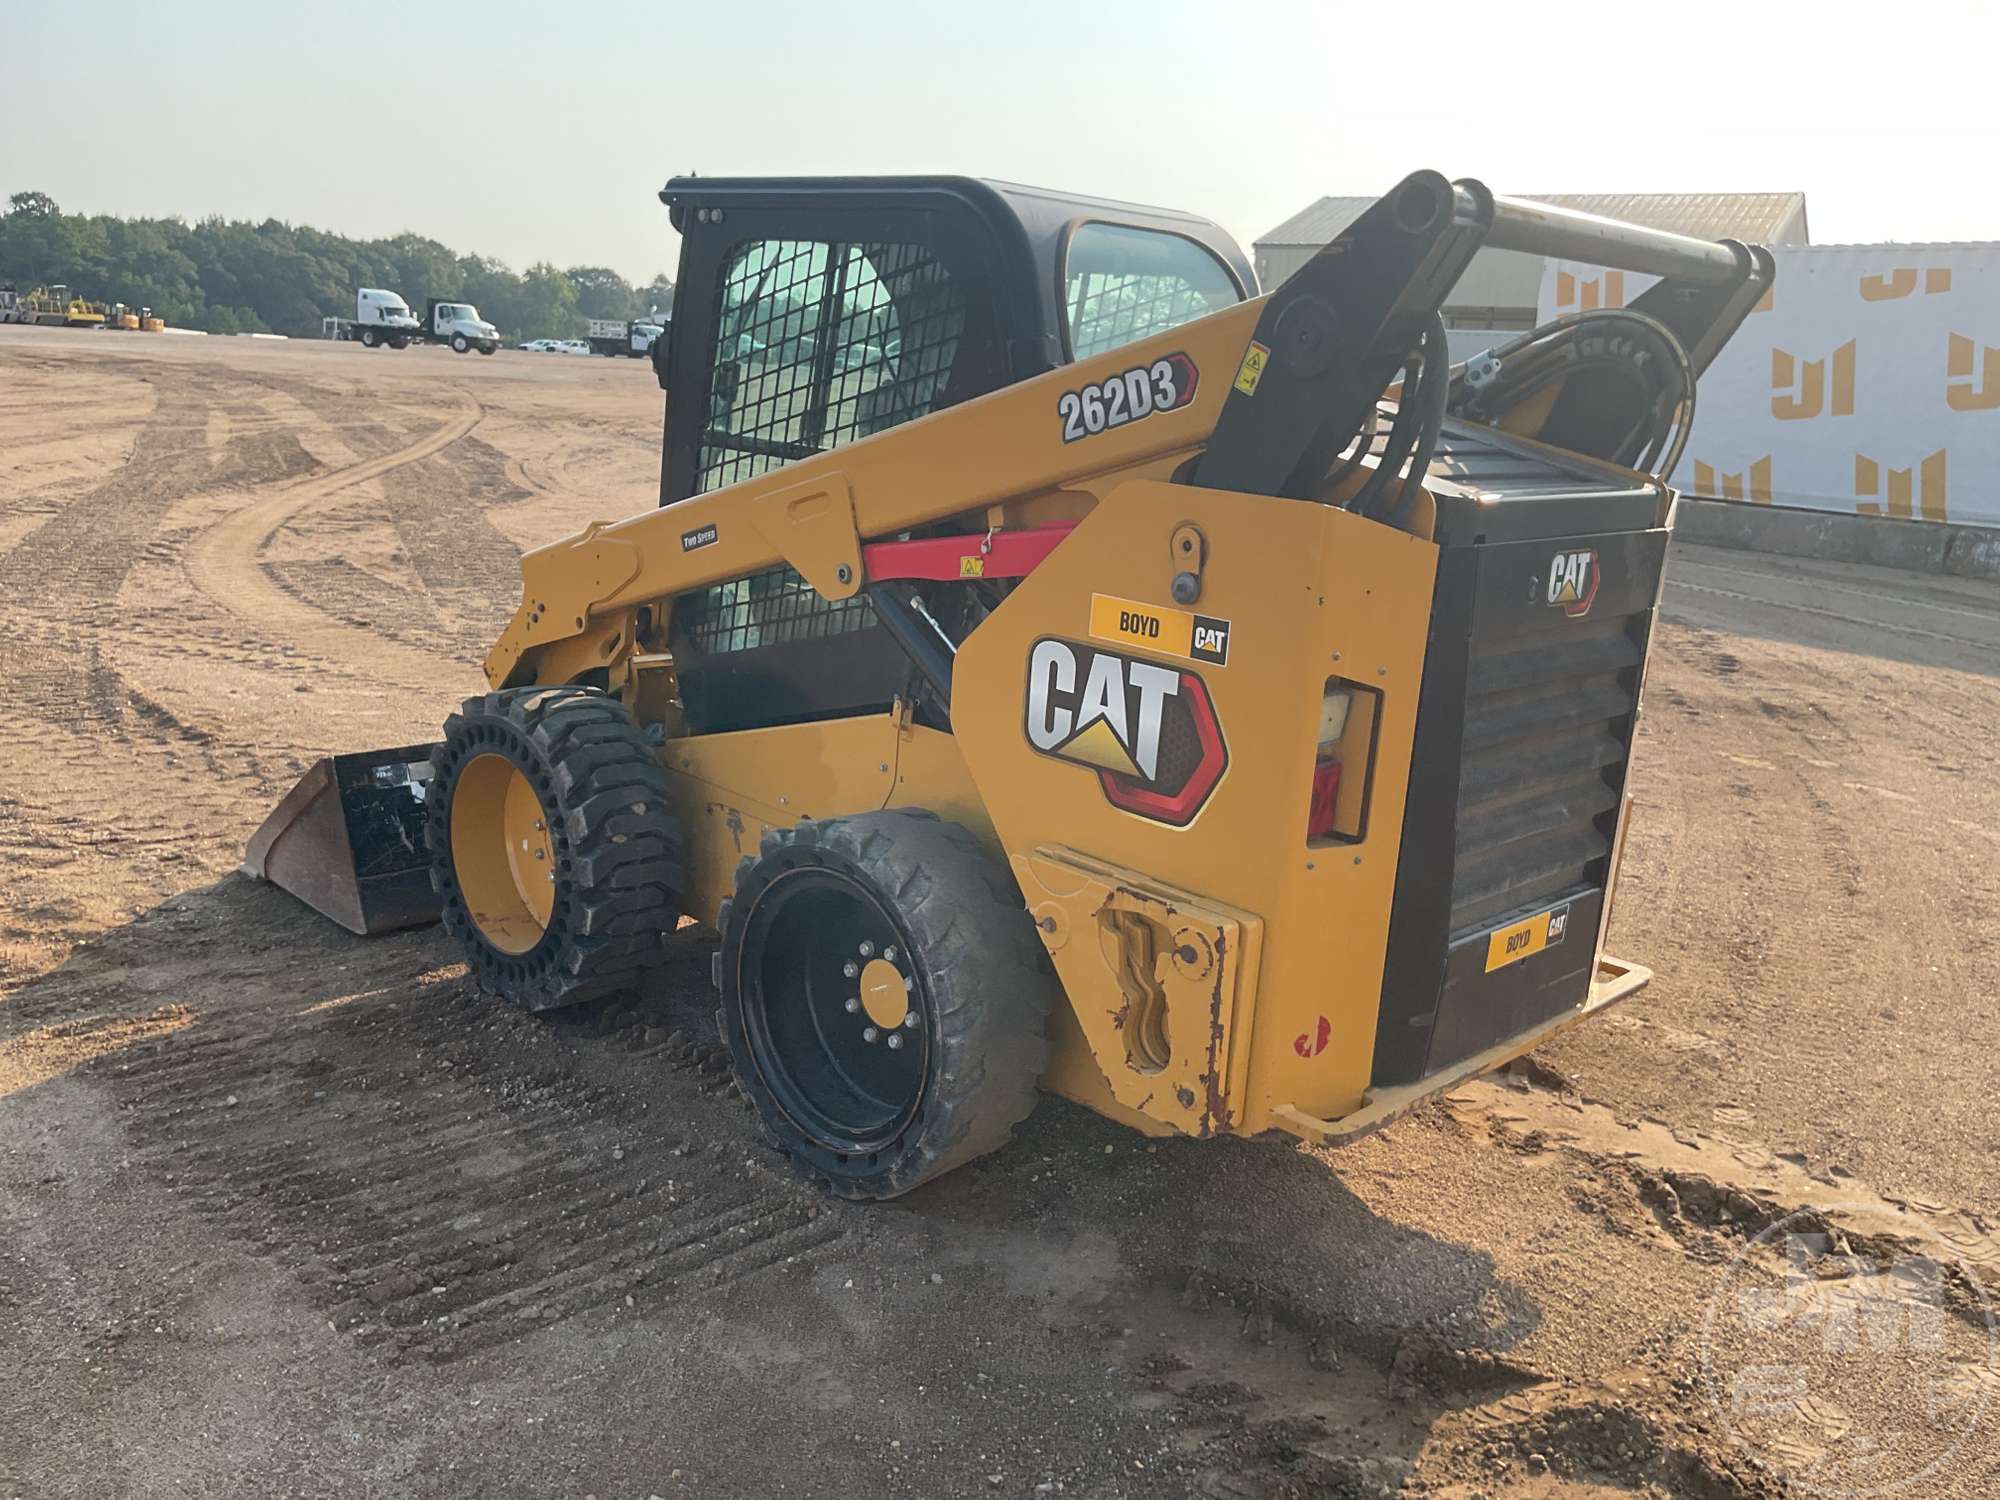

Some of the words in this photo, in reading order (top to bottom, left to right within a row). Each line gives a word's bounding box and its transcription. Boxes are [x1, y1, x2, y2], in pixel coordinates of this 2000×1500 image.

[1060, 361, 1176, 441] 262D3
[1548, 552, 1591, 602] CAT
[1120, 611, 1160, 638] BOYD
[1194, 626, 1226, 653] CAT
[1027, 640, 1179, 781] CAT
[1506, 929, 1531, 954] BOYD
[1548, 914, 1566, 937] CAT
